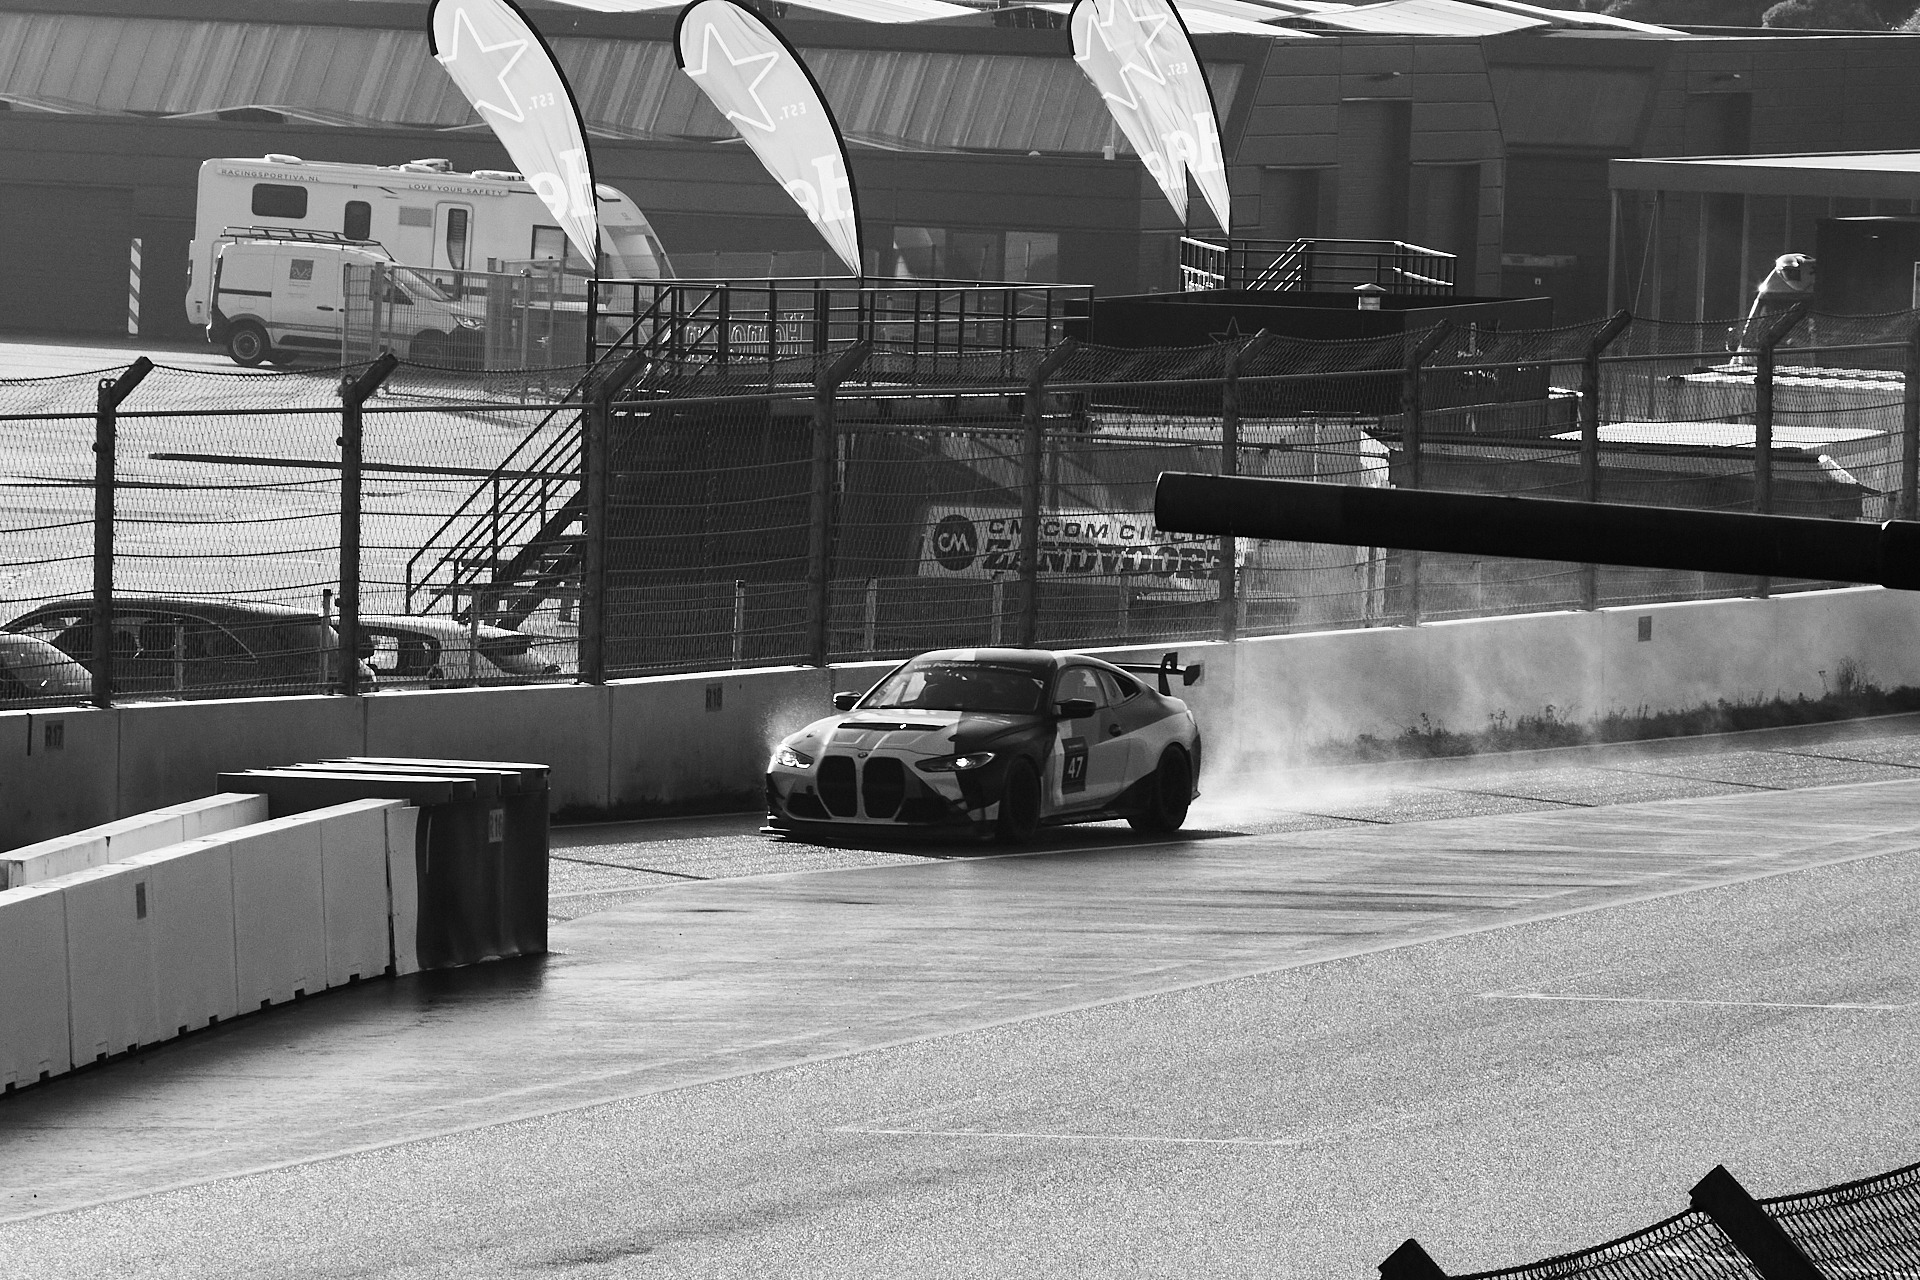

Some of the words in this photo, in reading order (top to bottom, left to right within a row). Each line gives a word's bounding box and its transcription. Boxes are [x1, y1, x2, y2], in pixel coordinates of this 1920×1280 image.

[221, 168, 319, 182] RACINGSPORTIVA.NL
[466, 188, 503, 196] SAFETY
[938, 532, 970, 552] CM
[1068, 756, 1084, 778] 47
